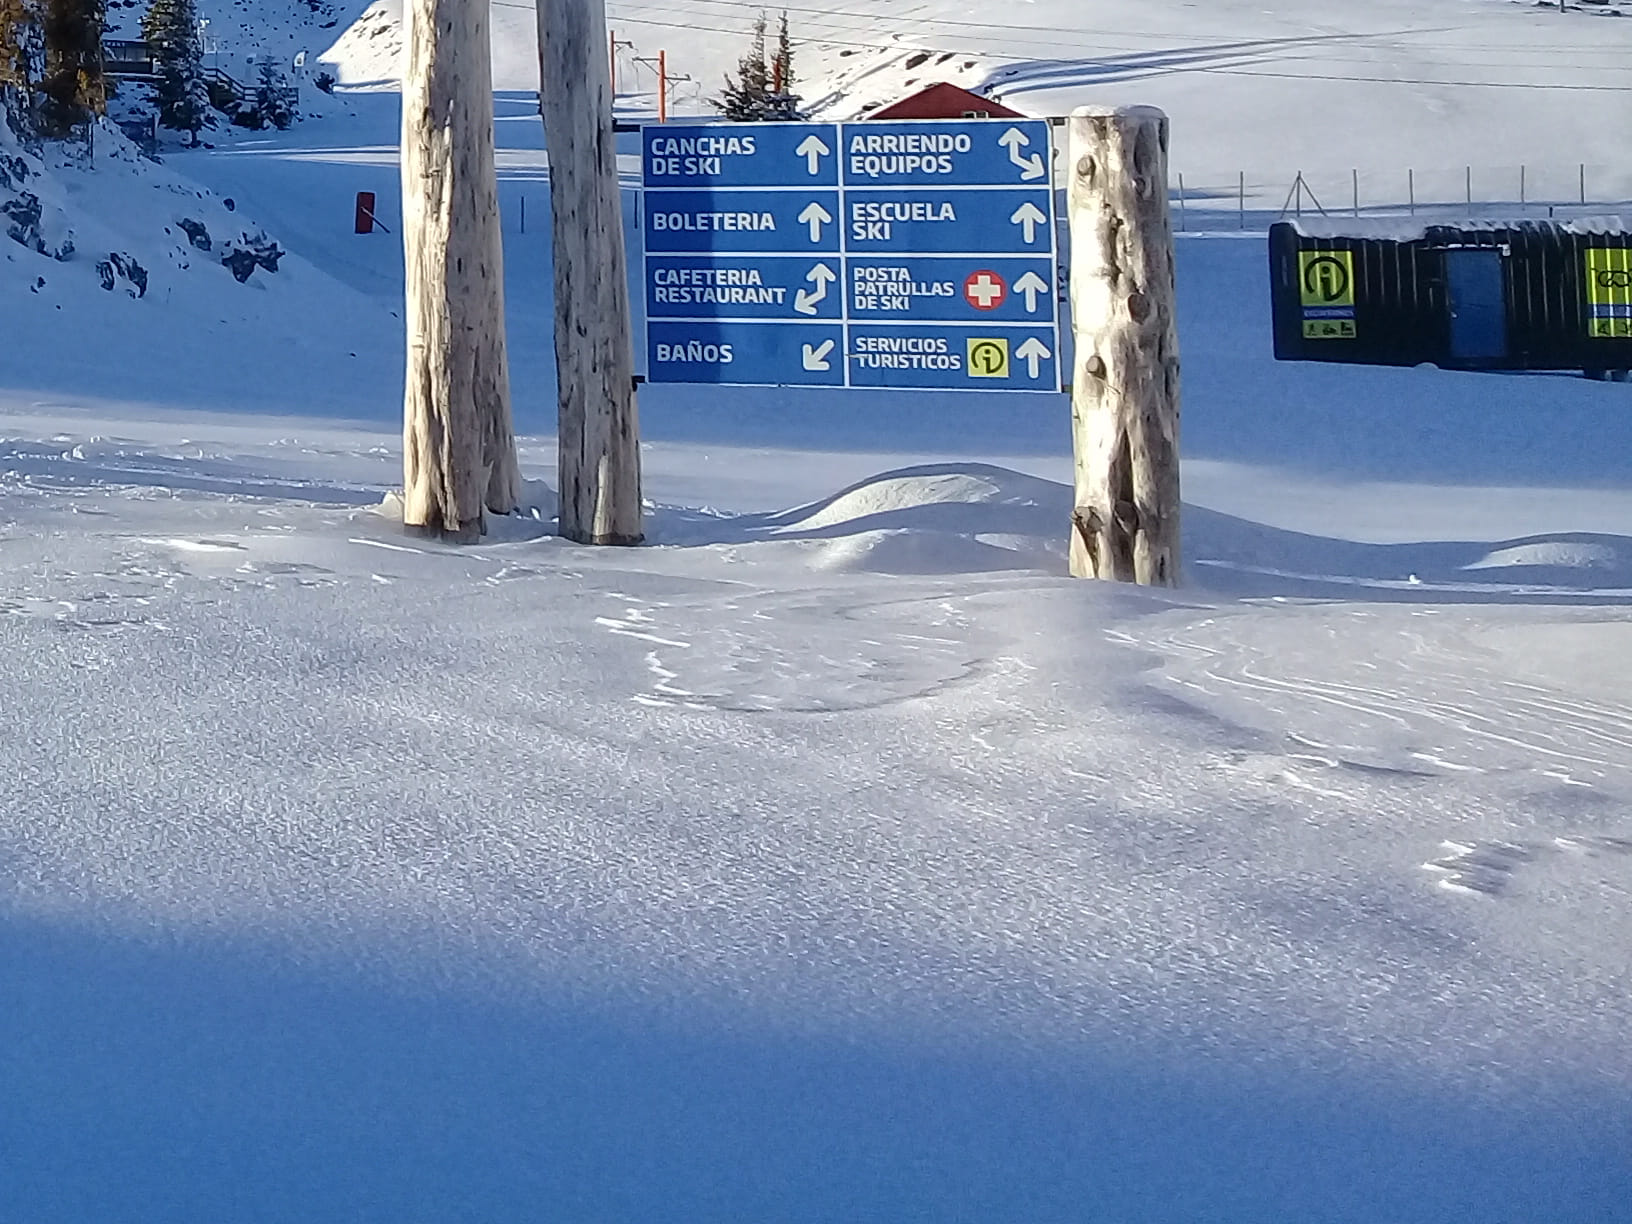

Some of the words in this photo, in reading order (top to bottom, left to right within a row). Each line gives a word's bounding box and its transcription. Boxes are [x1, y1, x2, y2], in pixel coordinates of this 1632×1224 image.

[651, 136, 755, 156] CANCHAS
[850, 134, 971, 153] ARRIENDO
[653, 157, 681, 175] DE
[684, 157, 721, 175] SKI
[852, 155, 953, 175] EQUIPOS
[852, 203, 956, 222] ESCUELA
[653, 213, 776, 230] BOLETERIA
[853, 222, 891, 240] SKI
[654, 269, 762, 286] CAFETERIA
[854, 267, 911, 281] POSTA
[655, 287, 786, 304] RESTAURANT
[855, 281, 954, 296] PATRULLAS
[855, 296, 878, 310] DE
[881, 296, 910, 310] SKI
[657, 340, 733, 363] BAÑOS
[856, 337, 947, 352] SERVICIOS
[856, 353, 961, 370] TURISTICOS
